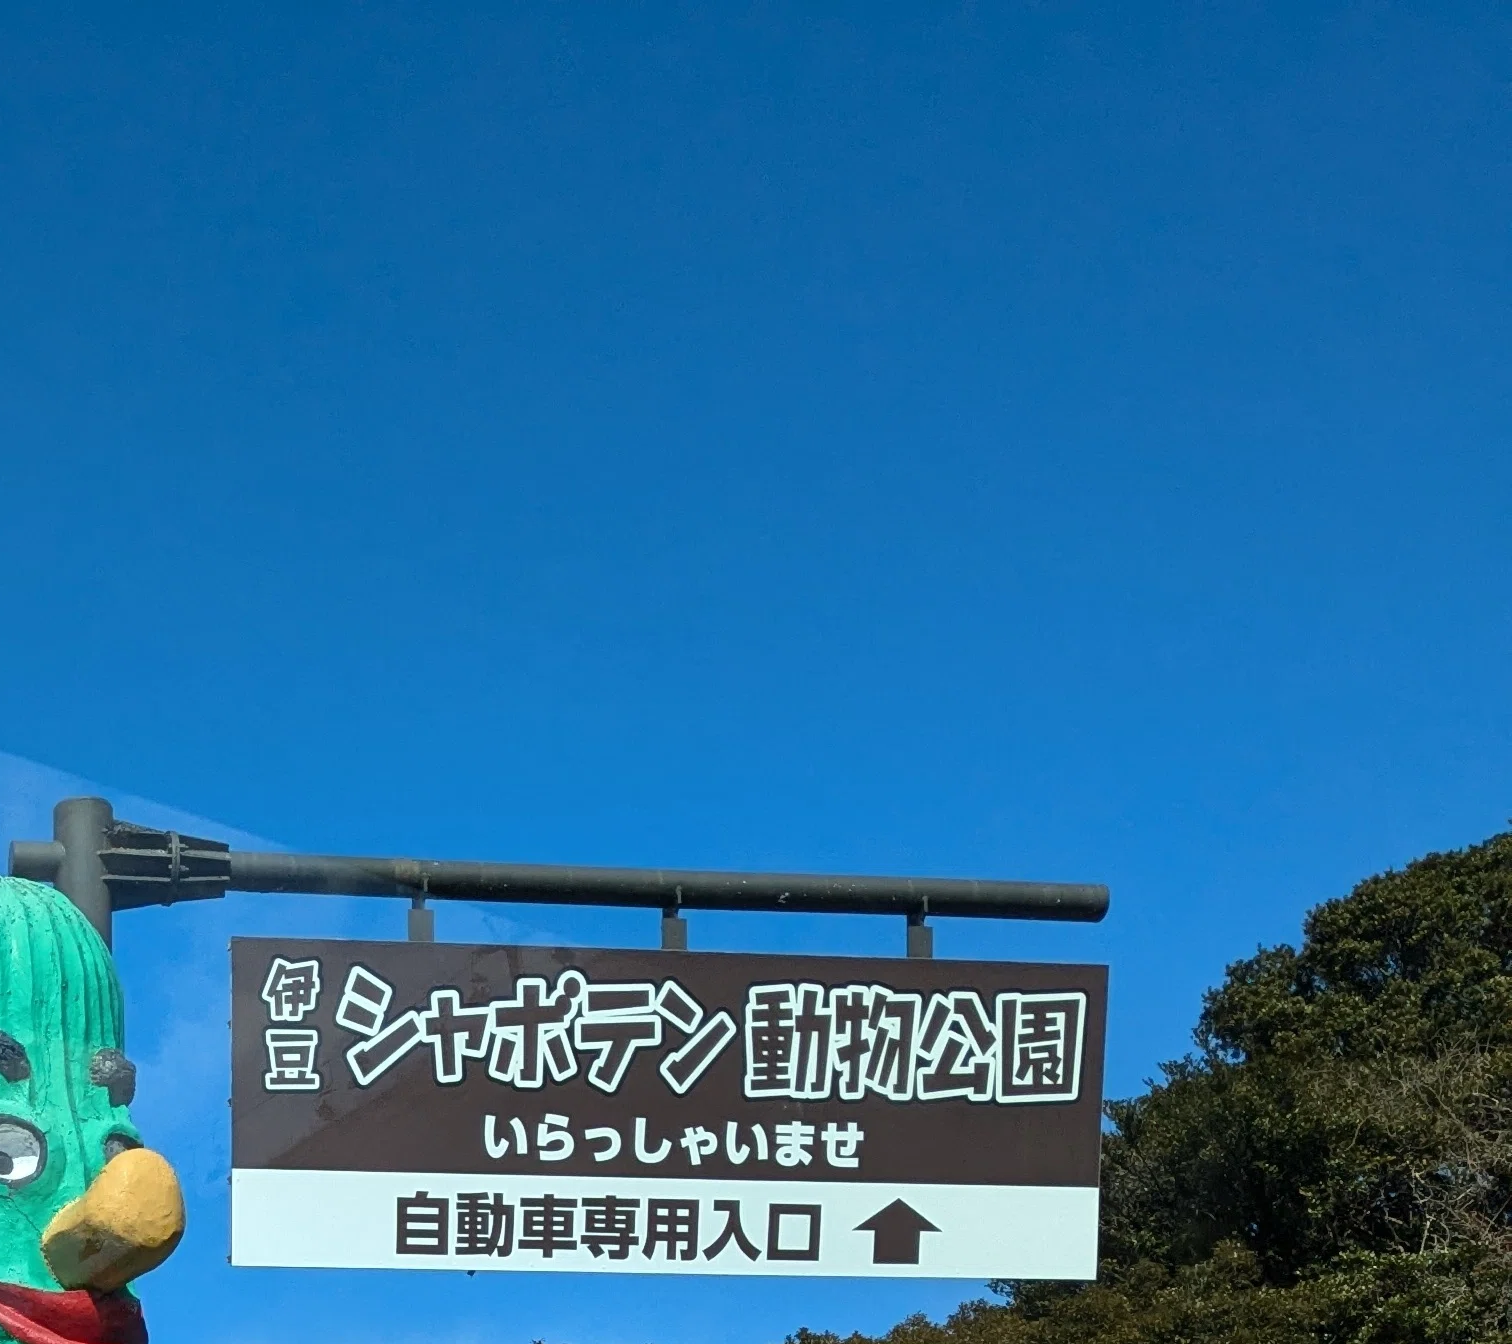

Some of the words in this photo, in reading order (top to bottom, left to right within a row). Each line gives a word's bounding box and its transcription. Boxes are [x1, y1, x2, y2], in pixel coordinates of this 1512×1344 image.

[261, 957, 321, 1090] 伊豆
[483, 1113, 865, 1168] いらっしゃいませ
[395, 1190, 823, 1263] 自動車専用入口
